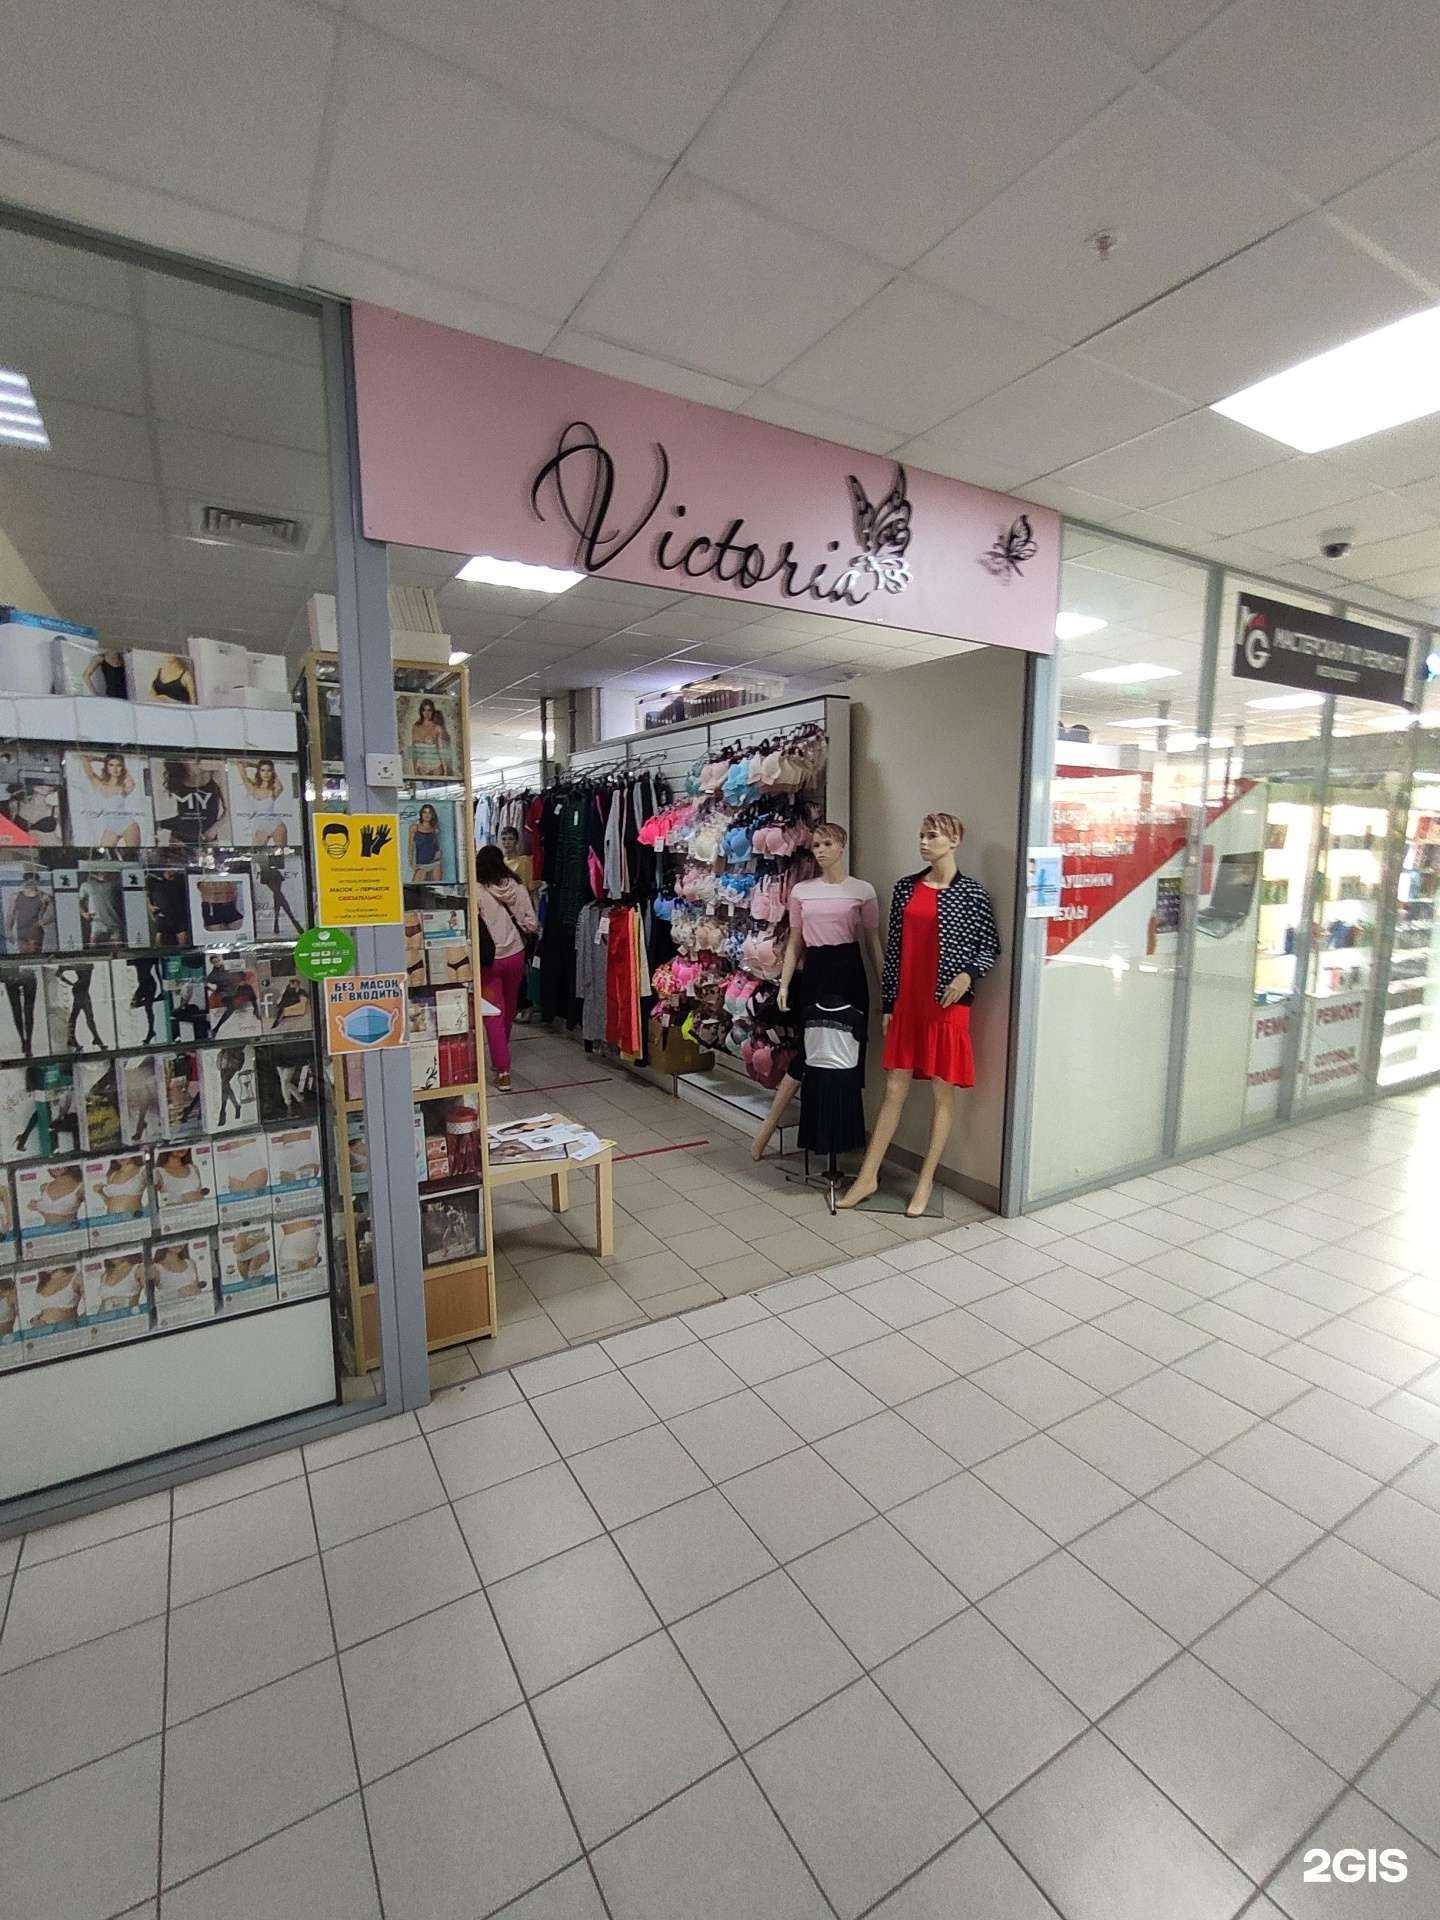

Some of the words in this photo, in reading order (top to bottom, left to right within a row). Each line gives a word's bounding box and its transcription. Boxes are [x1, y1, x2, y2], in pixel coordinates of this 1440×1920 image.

[531, 421, 870, 605] Victoria
[170, 791, 213, 810] MY
[334, 981, 355, 992] БЕЗ
[360, 979, 399, 990] МАСОК
[330, 992, 344, 1002] НЕ
